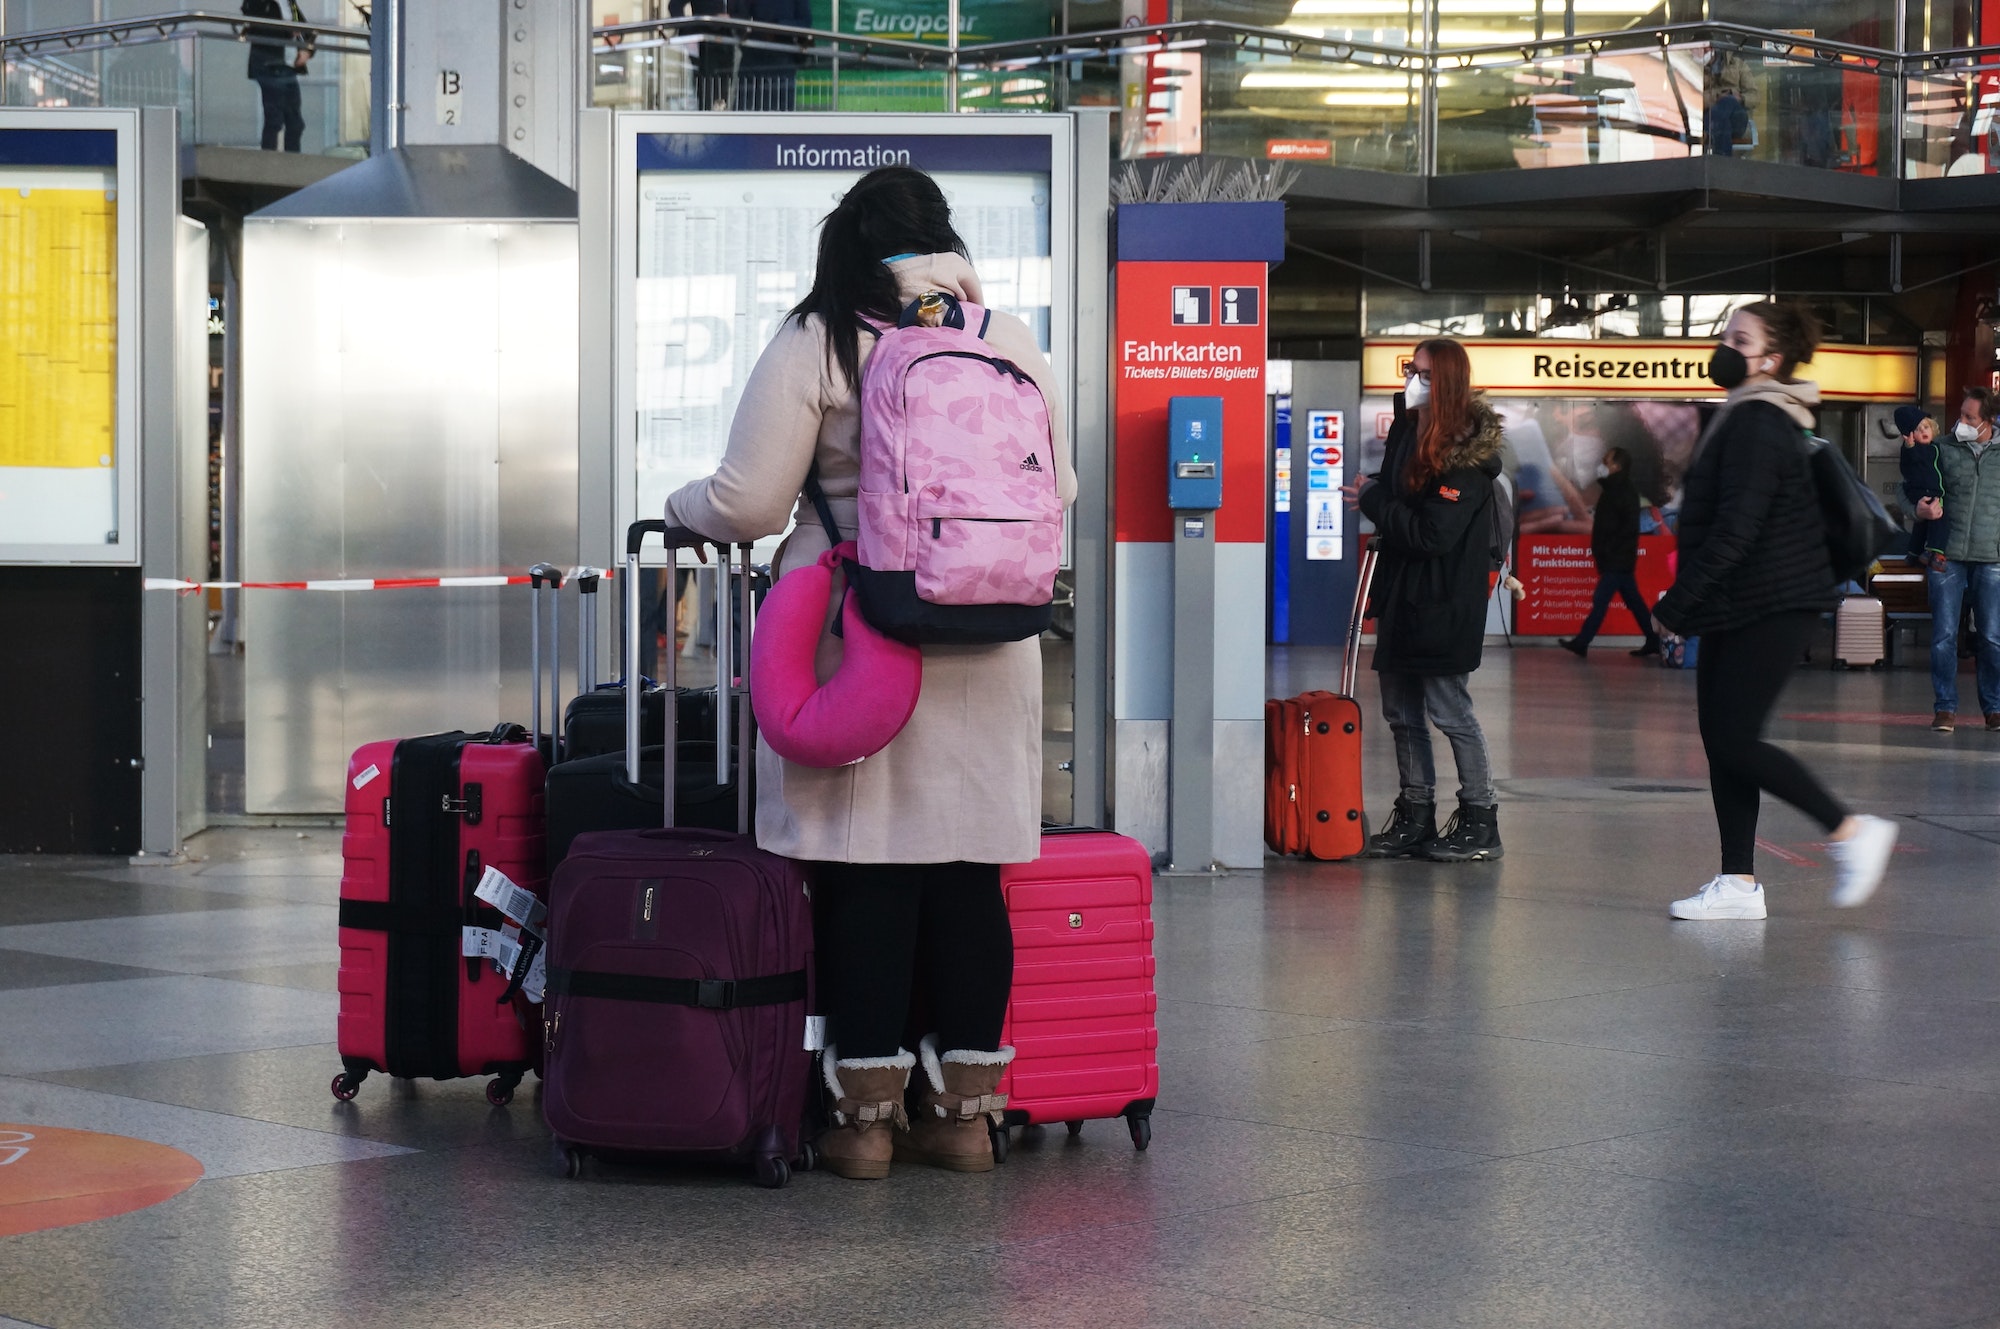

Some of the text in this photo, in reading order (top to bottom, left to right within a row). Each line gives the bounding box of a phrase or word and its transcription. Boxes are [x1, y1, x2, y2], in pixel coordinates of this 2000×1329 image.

[776, 143, 911, 167] Information
[1124, 341, 1242, 362] Fahrkarten
[1534, 354, 1712, 378] Reisezentru
[1532, 545, 1550, 555] Mit
[1552, 545, 1583, 555] vielen
[1532, 558, 1595, 567] Funktionen:
[480, 931, 488, 955] FRA
